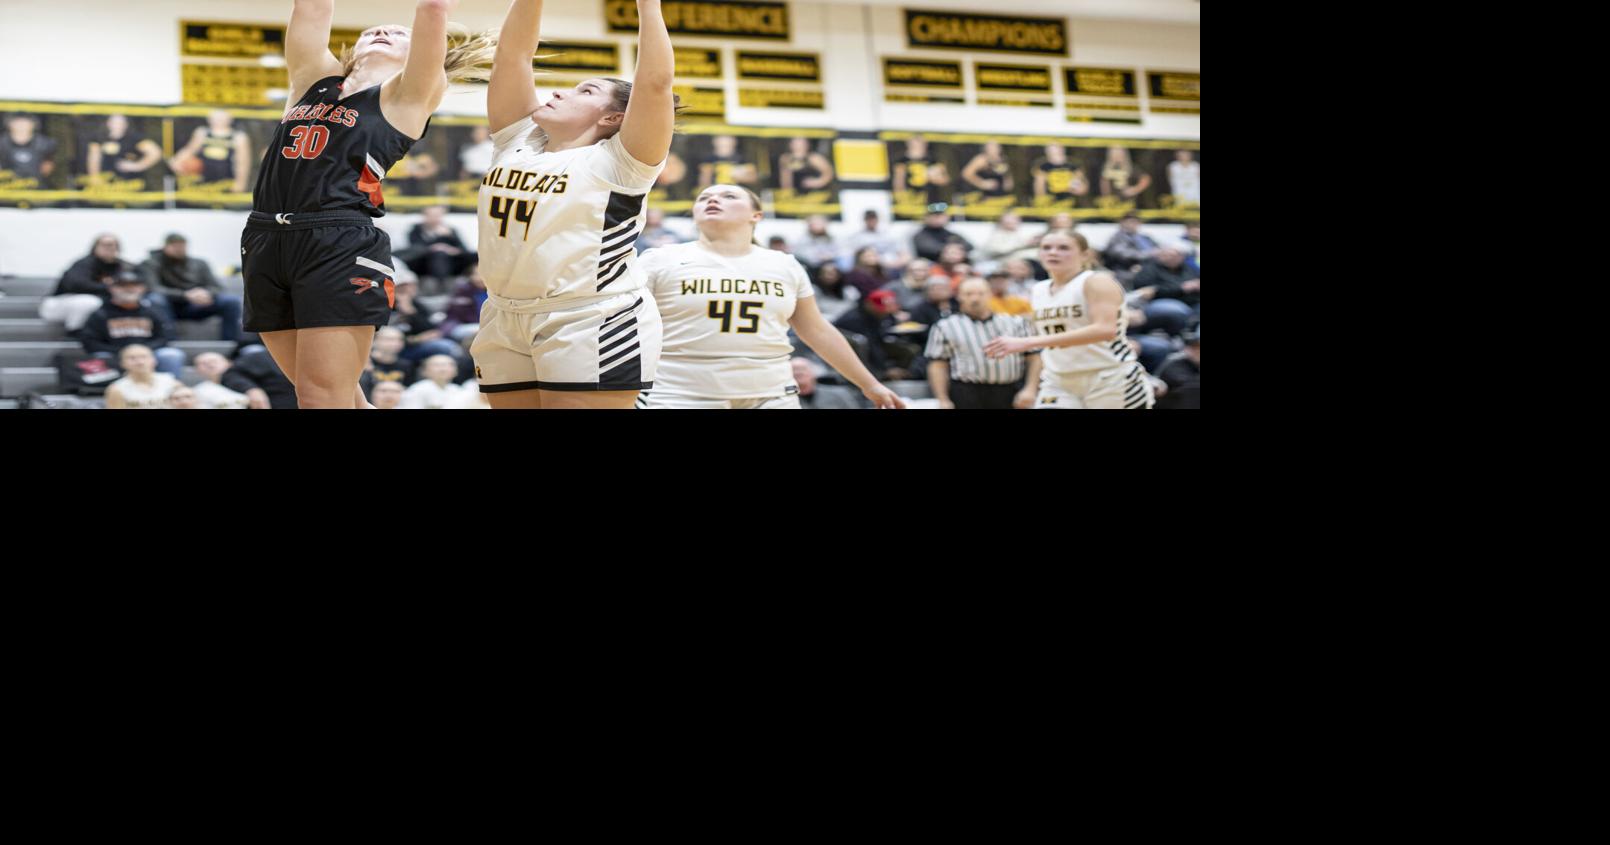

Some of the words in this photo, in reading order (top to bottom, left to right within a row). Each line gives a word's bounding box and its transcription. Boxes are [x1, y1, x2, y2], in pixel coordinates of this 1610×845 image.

[911, 15, 1063, 49] CHAMPIONS
[281, 125, 330, 159] 30
[489, 195, 538, 242] 44
[681, 278, 785, 298] WILDCATS
[707, 300, 764, 334] 45
